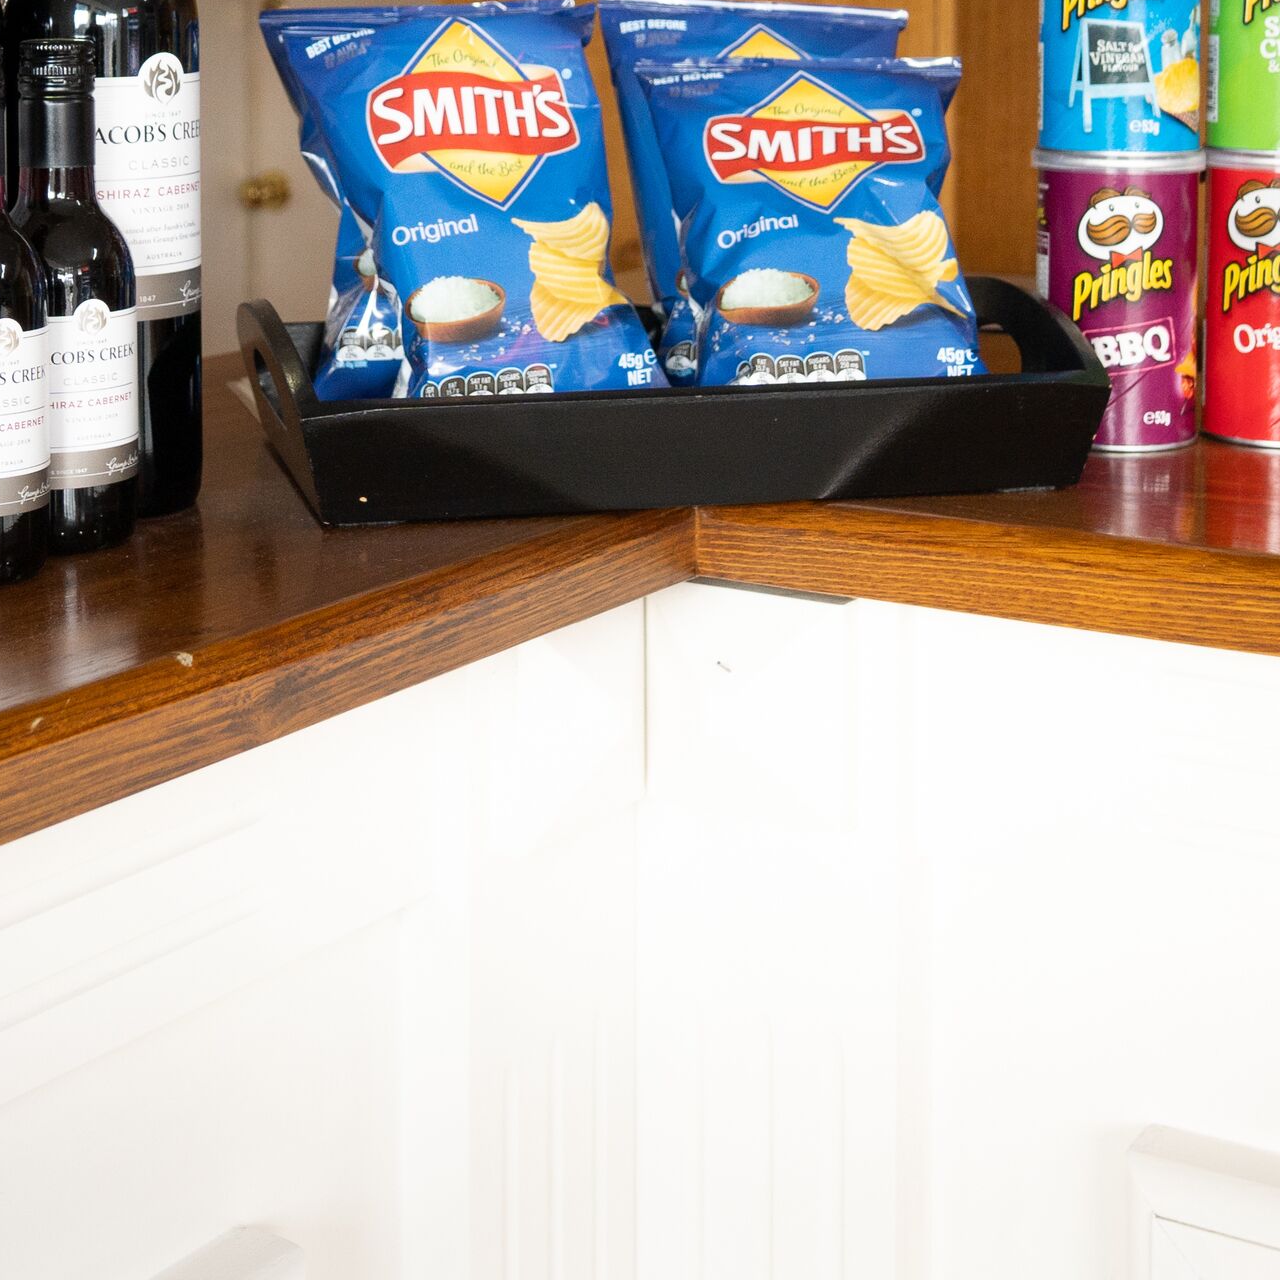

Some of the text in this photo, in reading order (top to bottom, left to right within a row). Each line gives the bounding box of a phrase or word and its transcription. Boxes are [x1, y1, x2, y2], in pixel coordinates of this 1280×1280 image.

[305, 36, 332, 60] BEST
[1097, 39, 1127, 52] SALT
[427, 52, 449, 68] The
[1090, 51, 1146, 66] VINEGAR
[1102, 63, 1139, 73] FLAVOUR
[1268, 59, 1280, 73] &
[372, 84, 571, 145] SMITH'S
[768, 97, 846, 118] The Original
[95, 119, 200, 145] ACOB'S CREE
[710, 122, 919, 164] SMITH'S
[128, 155, 190, 171] CLASSIC
[449, 158, 523, 177] and the Best
[779, 163, 860, 188] and the Best
[97, 187, 150, 201] SHIRAZ
[391, 213, 479, 246] Original
[717, 214, 799, 249] Original
[1072, 250, 1173, 322] Pringles
[139, 294, 157, 303] 1847
[1091, 325, 1172, 369] BBQ
[50, 348, 95, 366] COB'S
[63, 371, 119, 386] CLASSIC
[627, 367, 653, 387] NET
[50, 391, 132, 410] HIRAZ CABERNET
